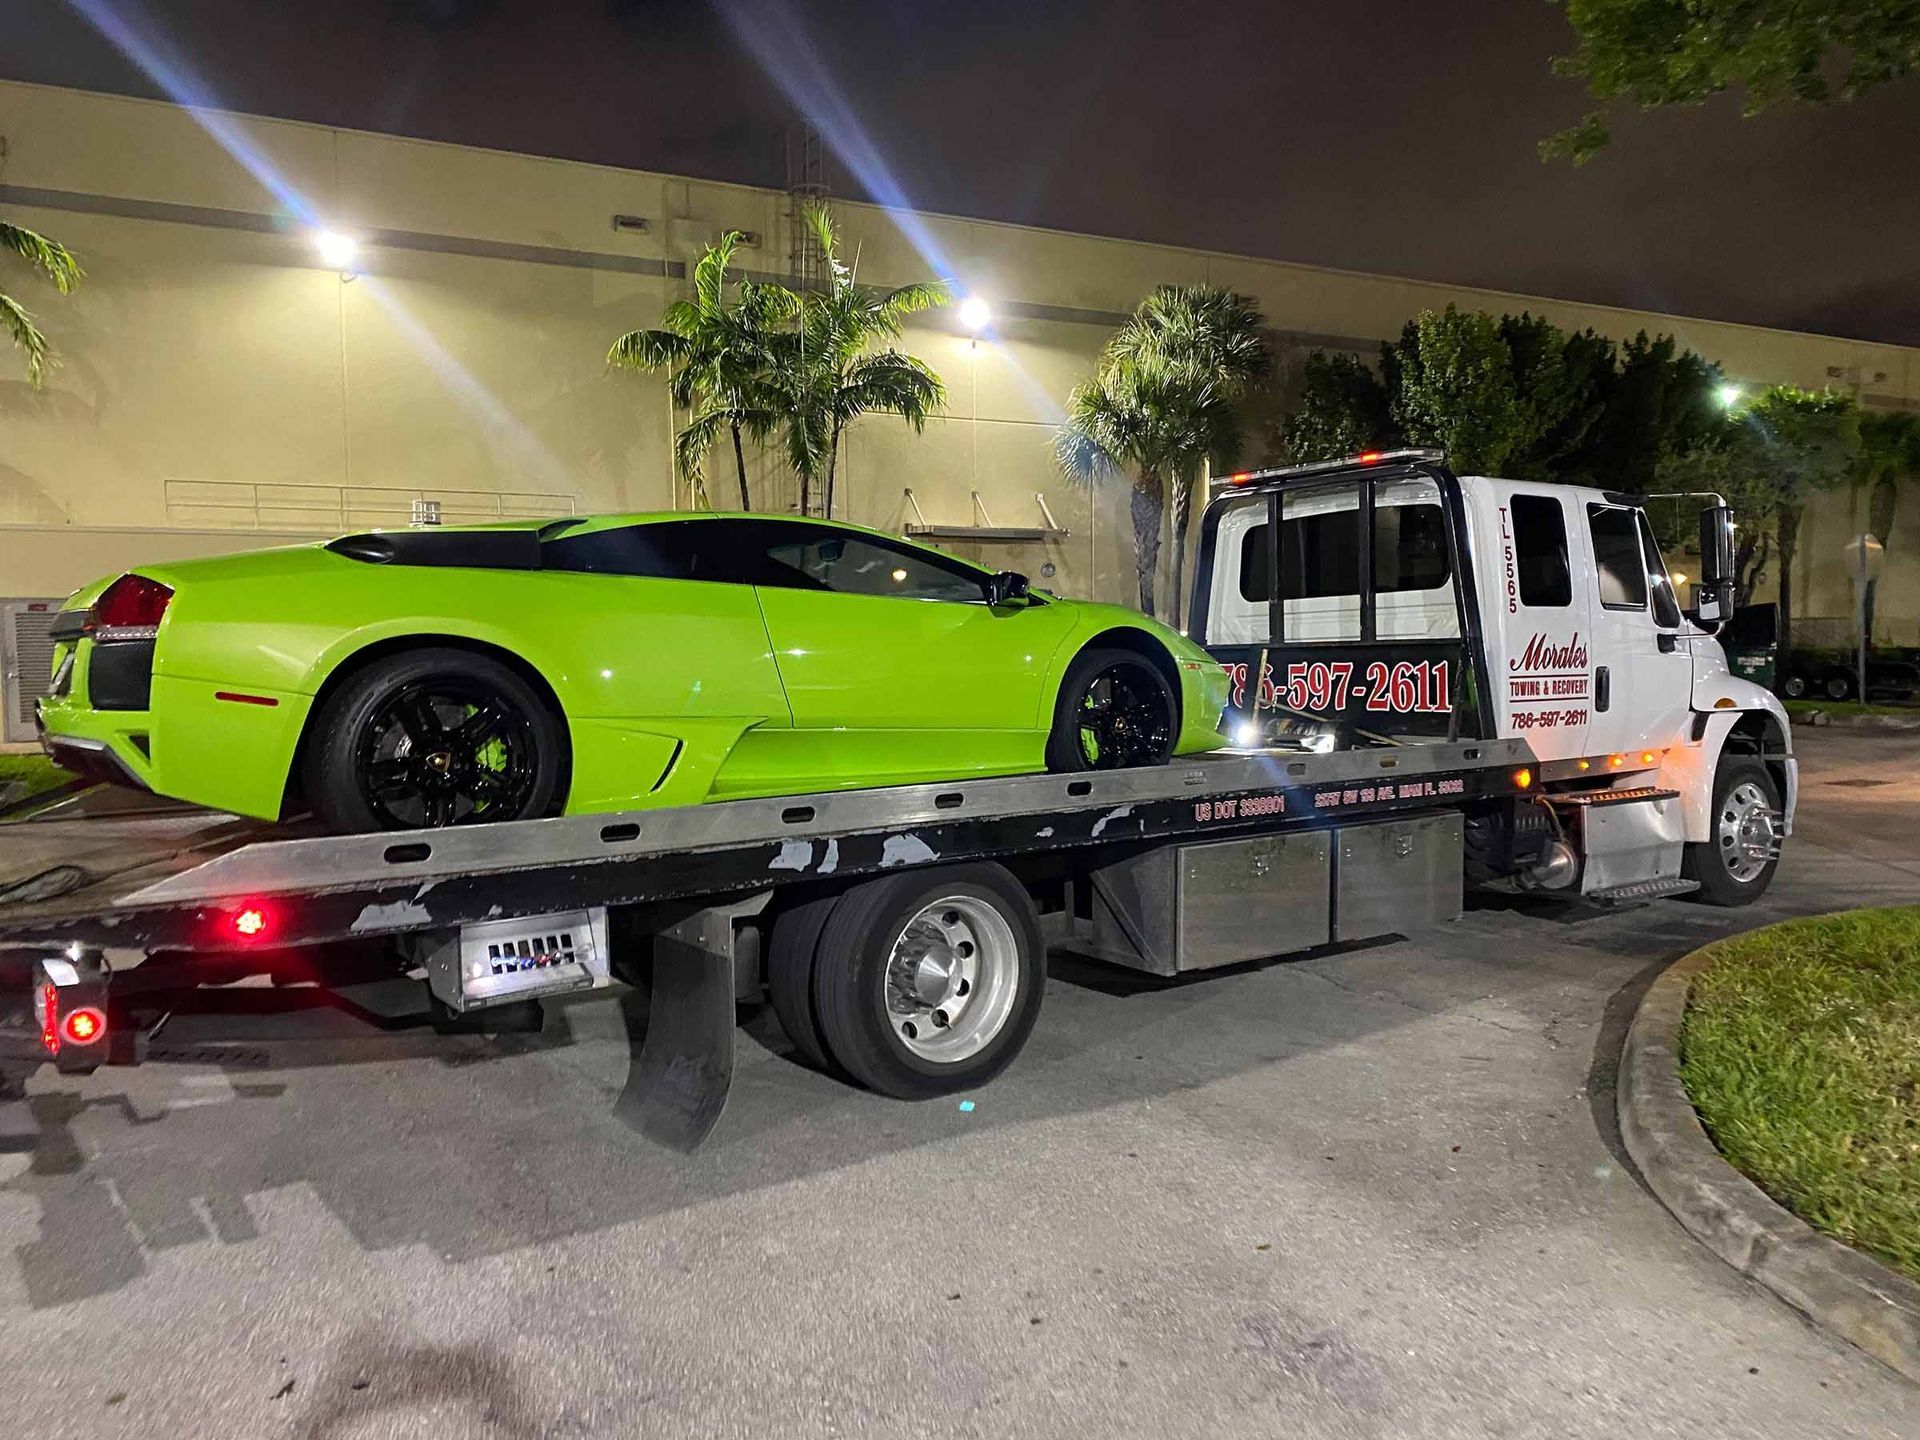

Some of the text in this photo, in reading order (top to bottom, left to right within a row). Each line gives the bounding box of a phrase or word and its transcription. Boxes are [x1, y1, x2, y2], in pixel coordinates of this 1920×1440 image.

[1499, 508, 1517, 614] TL 5565
[1510, 632, 1588, 672] Morales
[1510, 679, 1588, 697] TOWING & RECOVERY
[1511, 709, 1588, 730] 786-597-2611
[1399, 783, 1423, 799] MIAMI
[1195, 802, 1212, 822] US
[1214, 800, 1238, 819] DOT
